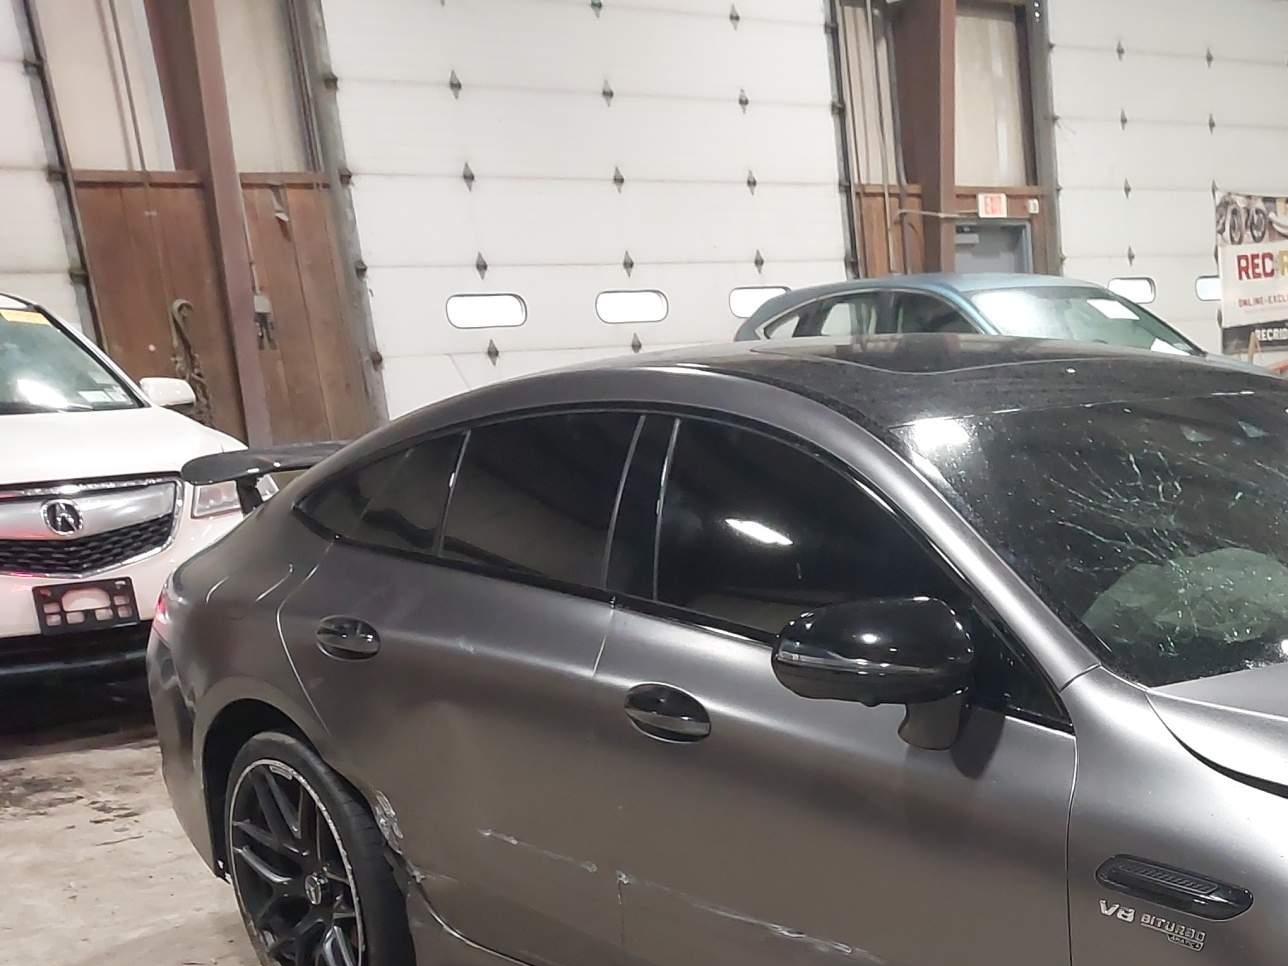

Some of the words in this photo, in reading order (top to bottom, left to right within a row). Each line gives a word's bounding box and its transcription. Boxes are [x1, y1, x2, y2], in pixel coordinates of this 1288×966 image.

[1236, 252, 1275, 281] REC
[1099, 899, 1136, 923] V8
[1140, 913, 1206, 942] BITURBO
